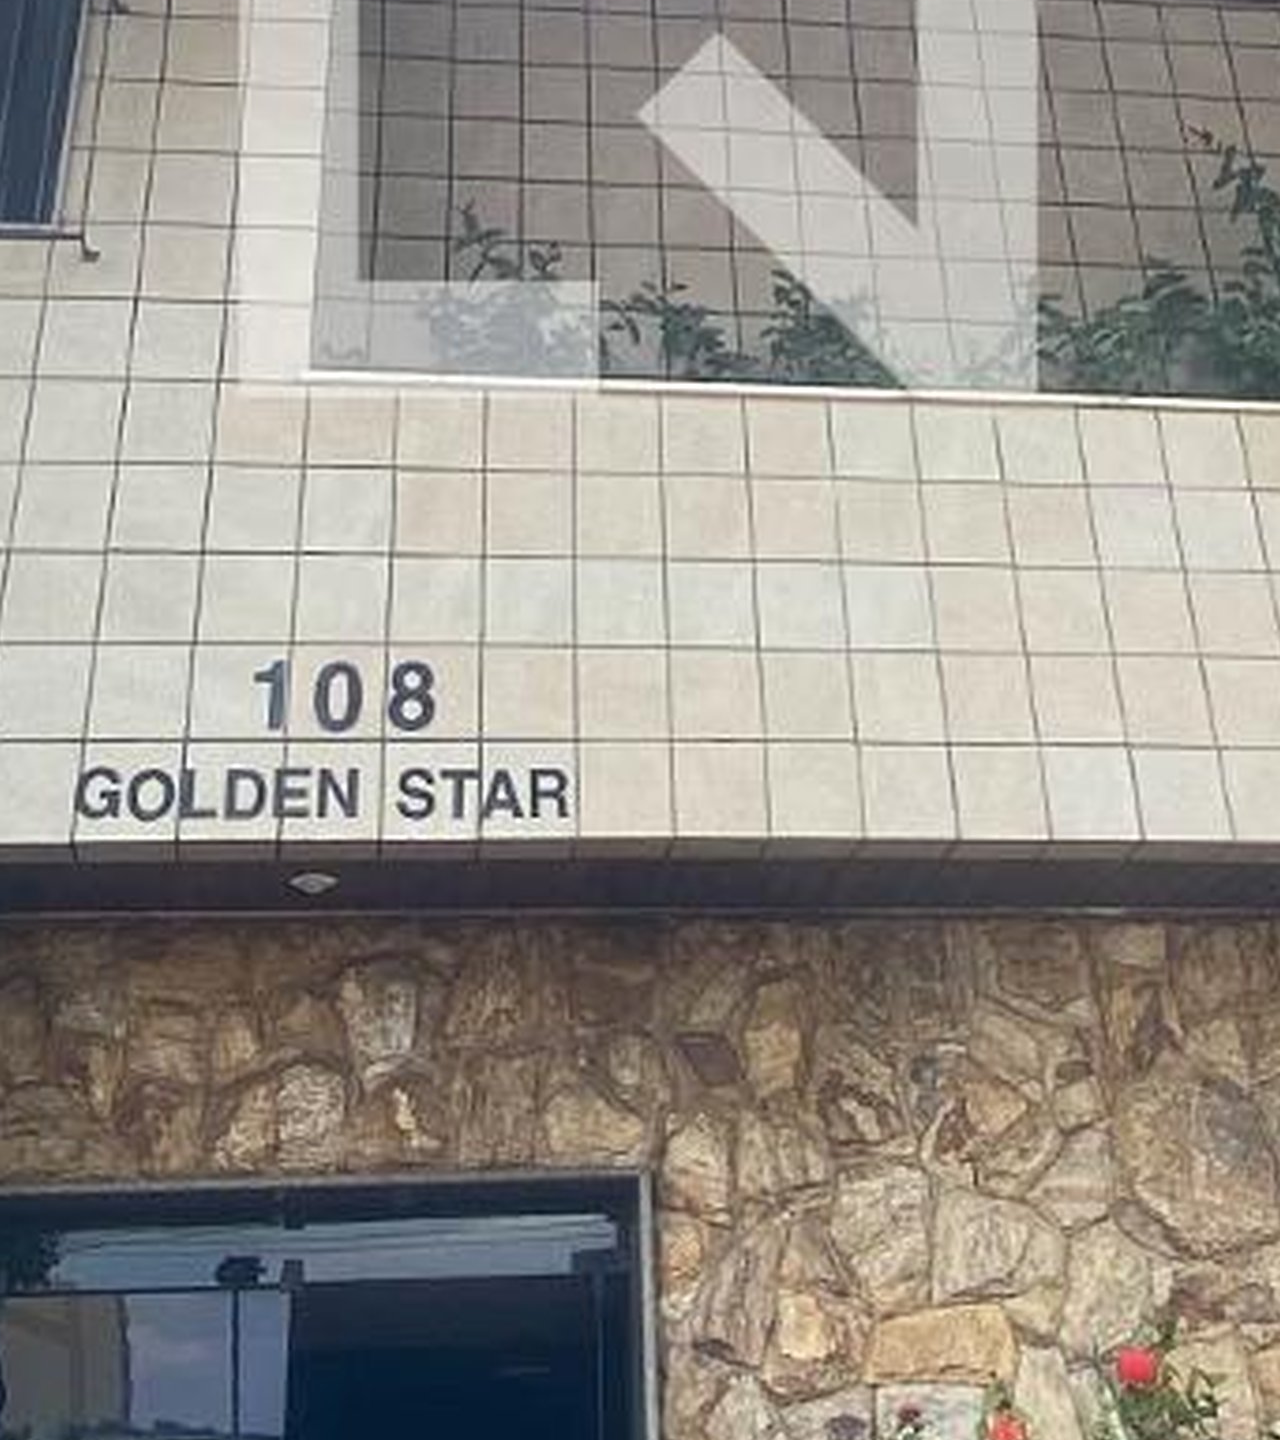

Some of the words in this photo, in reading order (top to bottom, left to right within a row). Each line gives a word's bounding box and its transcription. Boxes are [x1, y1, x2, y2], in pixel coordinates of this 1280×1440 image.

[253, 659, 437, 733] 108
[75, 765, 360, 822] GOLDEN
[396, 766, 570, 820] STAR
